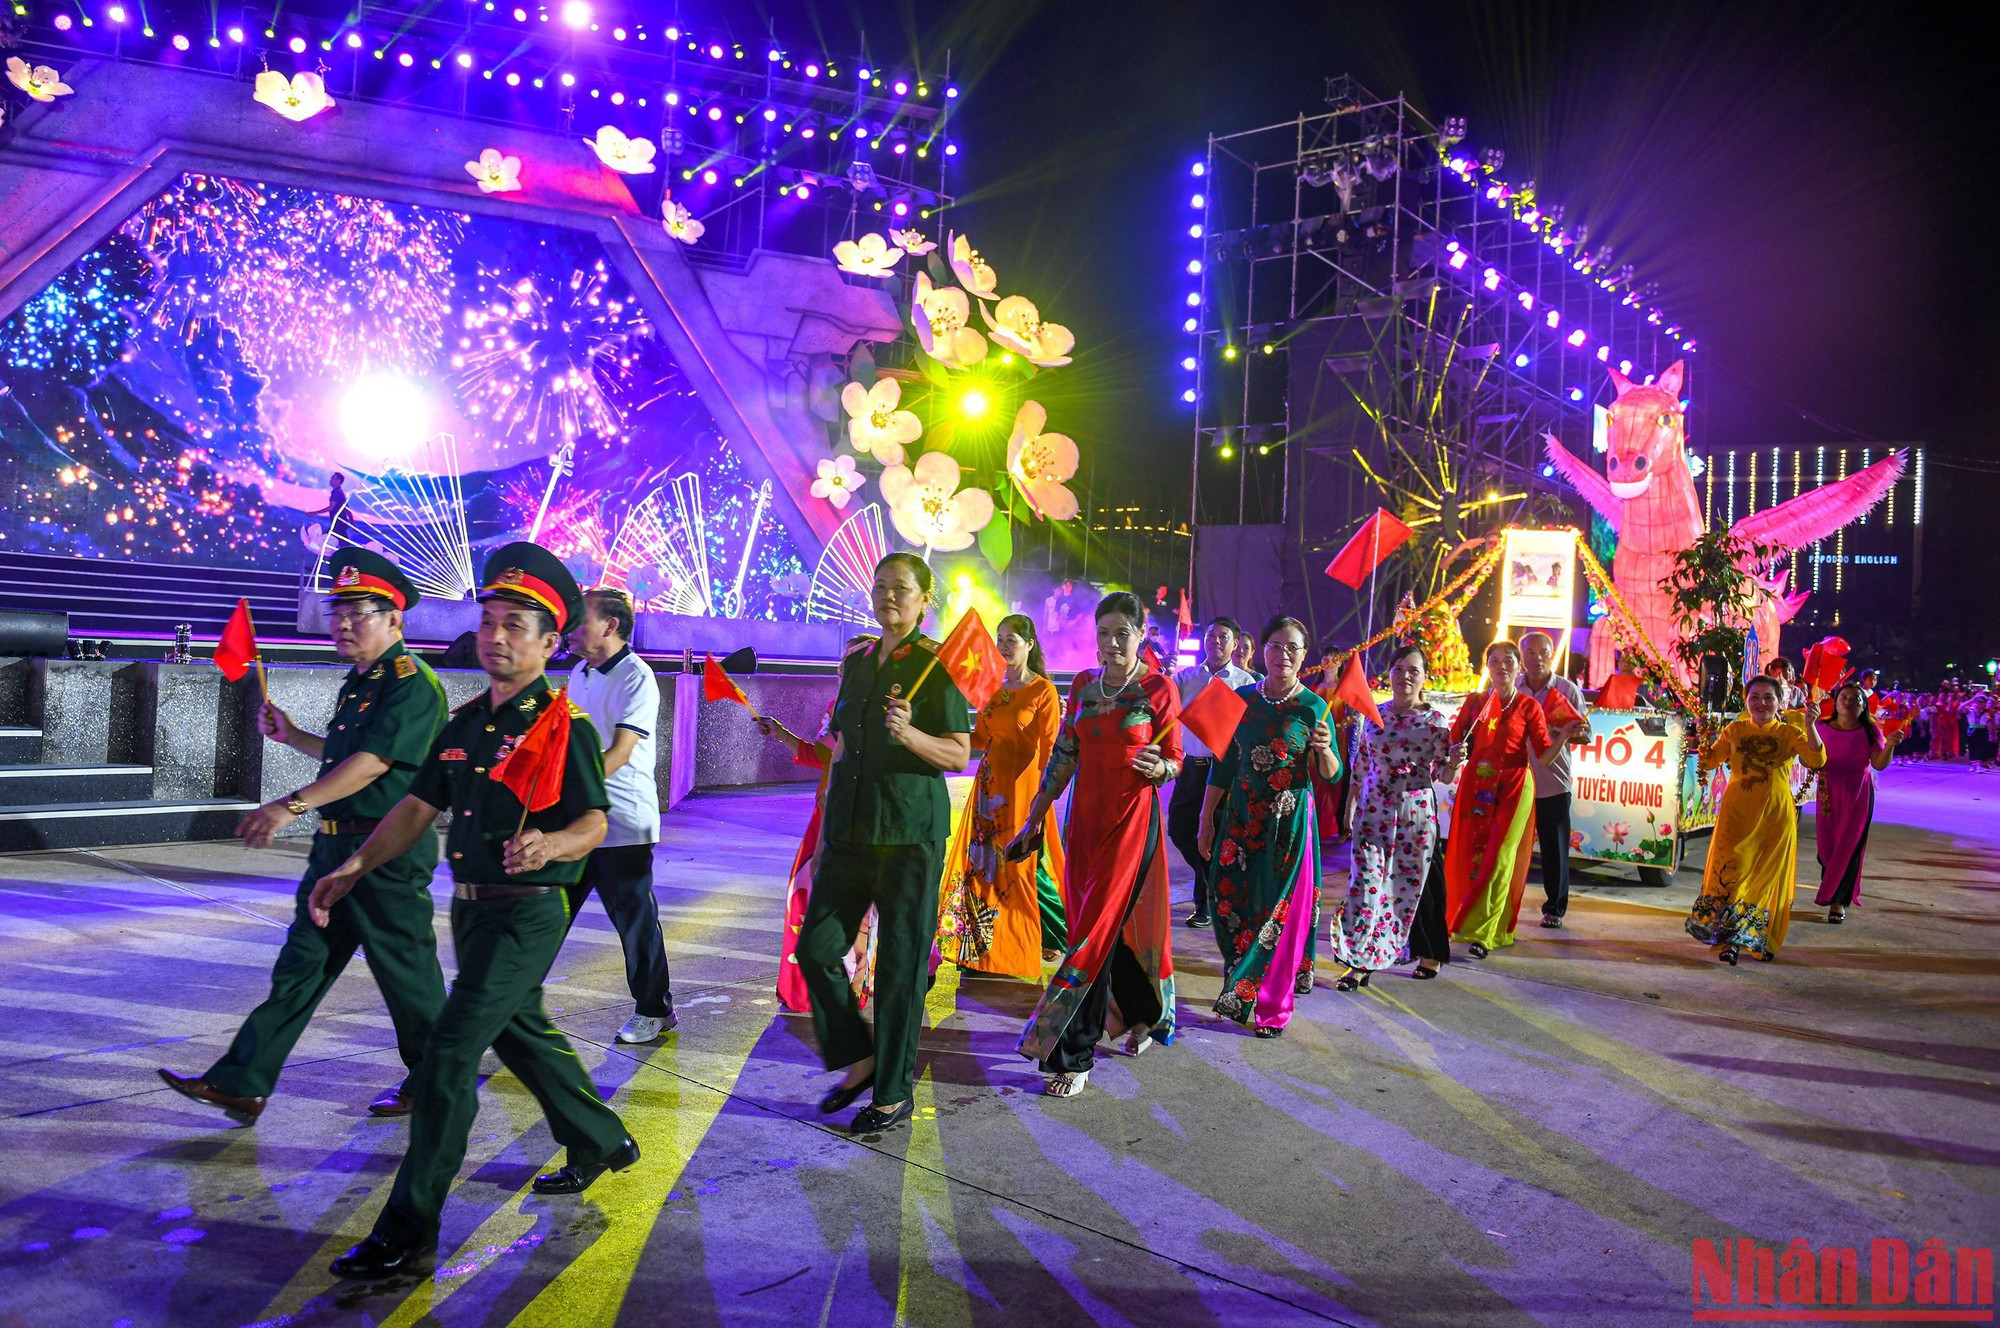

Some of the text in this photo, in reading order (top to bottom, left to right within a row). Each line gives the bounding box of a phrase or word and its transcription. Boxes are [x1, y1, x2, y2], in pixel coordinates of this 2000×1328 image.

[1854, 555, 1898, 564] ENGLISH
[1570, 723, 1666, 770] HỐ 4
[1577, 774, 1663, 808] TUYÊN QUANG
